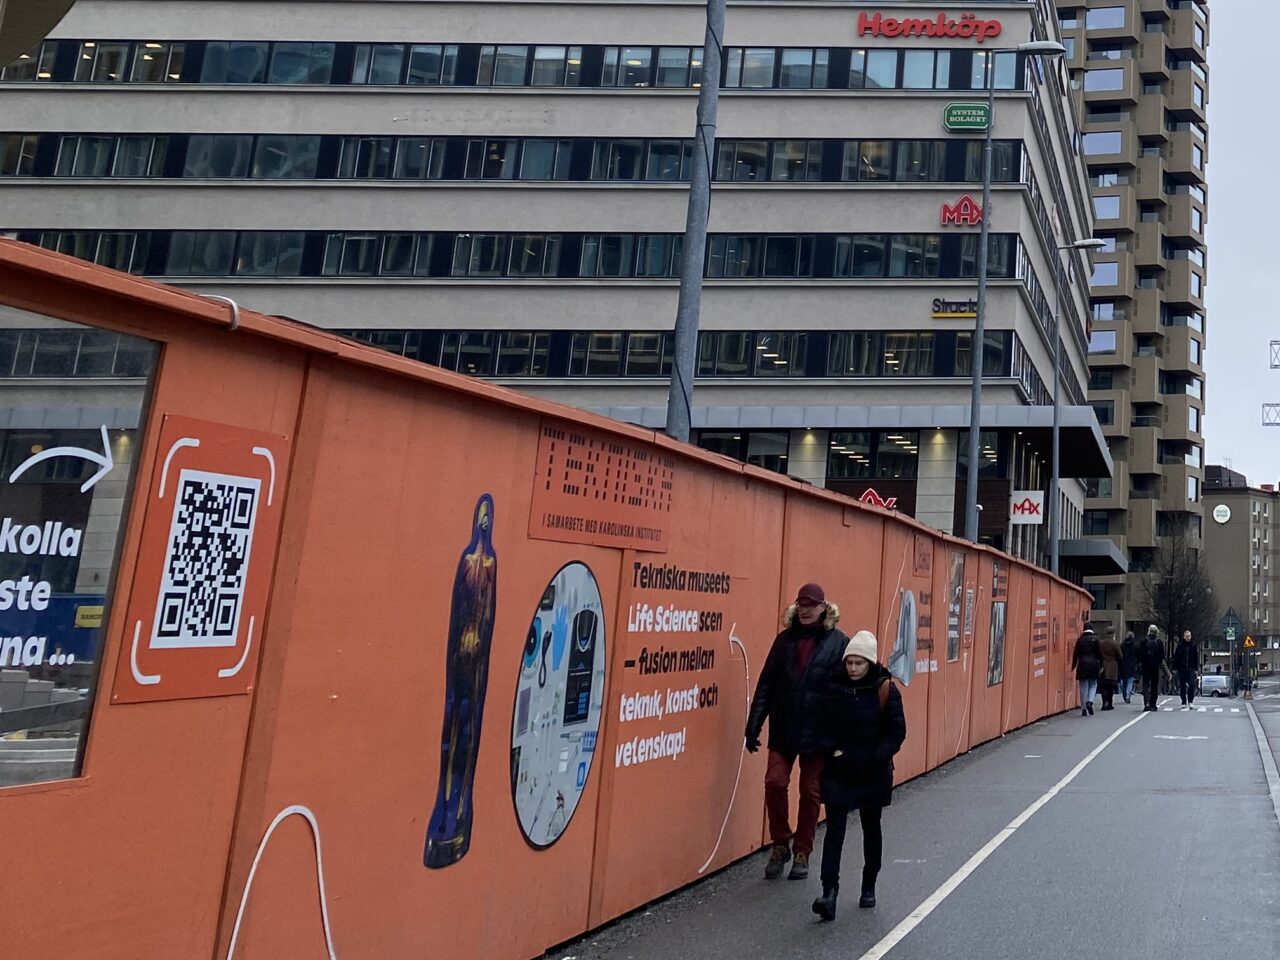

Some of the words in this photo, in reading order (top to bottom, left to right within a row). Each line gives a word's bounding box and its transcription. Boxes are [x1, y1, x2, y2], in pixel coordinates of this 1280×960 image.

[857, 11, 1003, 43] Hemköp
[932, 298, 978, 313] Structo
[1013, 497, 1041, 515] MAX
[0, 517, 82, 557] kolla
[546, 513, 584, 532] SAMARBETE
[584, 519, 598, 534] MED
[599, 521, 635, 537] KAROLINSKA
[633, 561, 687, 592] Tekniska
[687, 570, 731, 595] museets
[627, 602, 654, 632] Life
[654, 603, 698, 632] Science
[699, 611, 723, 632] scen
[639, 645, 678, 675] fusion
[678, 646, 715, 672] mellan
[619, 689, 664, 722] teknik,
[665, 683, 699, 715] konst
[699, 682, 718, 709] och
[615, 727, 687, 768] vetenskap!
